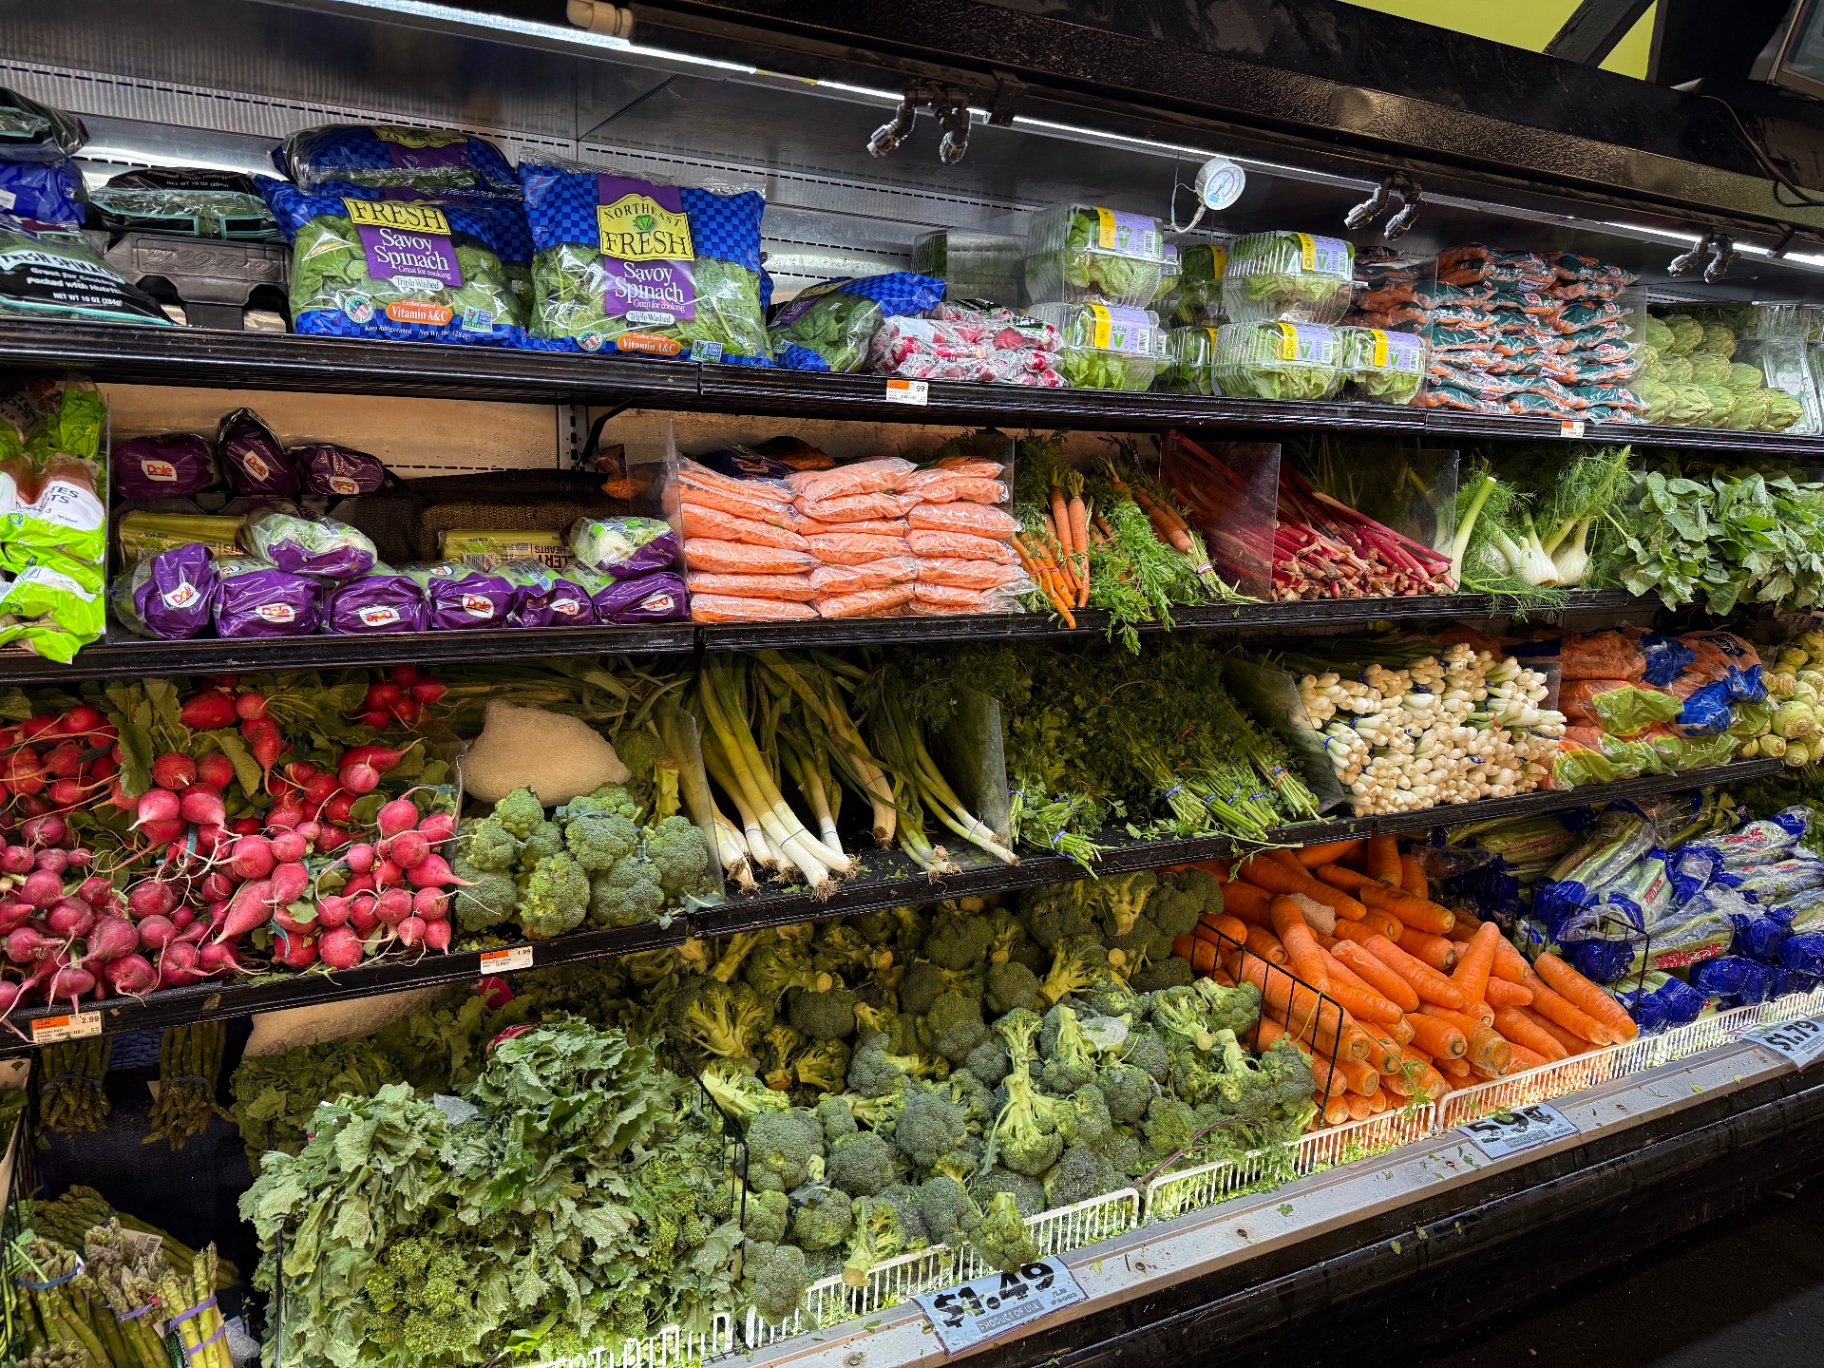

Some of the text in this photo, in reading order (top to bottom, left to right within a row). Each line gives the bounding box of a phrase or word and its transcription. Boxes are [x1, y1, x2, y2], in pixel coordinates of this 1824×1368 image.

[349, 202, 445, 230] FRESH
[604, 203, 681, 226] NORTHEAST
[380, 228, 432, 255] Savoy
[603, 230, 689, 255] FRESH
[374, 245, 450, 271] Spinach
[30, 267, 60, 277] Great
[62, 271, 78, 279] for
[398, 265, 416, 275] Great
[623, 262, 673, 286] Savoy
[26, 277, 64, 287] Packed
[65, 281, 89, 290] with
[395, 278, 439, 289] Triple Washed
[615, 276, 685, 303] Spinach
[53, 292, 67, 300] NET
[633, 299, 650, 308] Great
[652, 300, 660, 308] for
[392, 305, 448, 322] Vitamin A&C
[629, 312, 647, 322] Triple
[1112, 325, 1127, 334] GEN
[622, 337, 677, 354] Vitamin A&C
[1113, 333, 1125, 348] V
[147, 463, 173, 477] Dole
[245, 455, 267, 477] Dole
[332, 481, 356, 494] Dole
[535, 545, 566, 554] HEARTS
[537, 554, 574, 569] LERY
[171, 585, 193, 604] Dole
[467, 596, 491, 613] Dole
[645, 596, 669, 610] Dole
[261, 606, 291, 617] Dole
[366, 609, 394, 622] Dole
[81, 1015, 99, 1024] 2.99
[1763, 1020, 1820, 1052] $1.79
[933, 1262, 1055, 1329] $1.49
[979, 1302, 1040, 1332] PRODUCT OF USA
